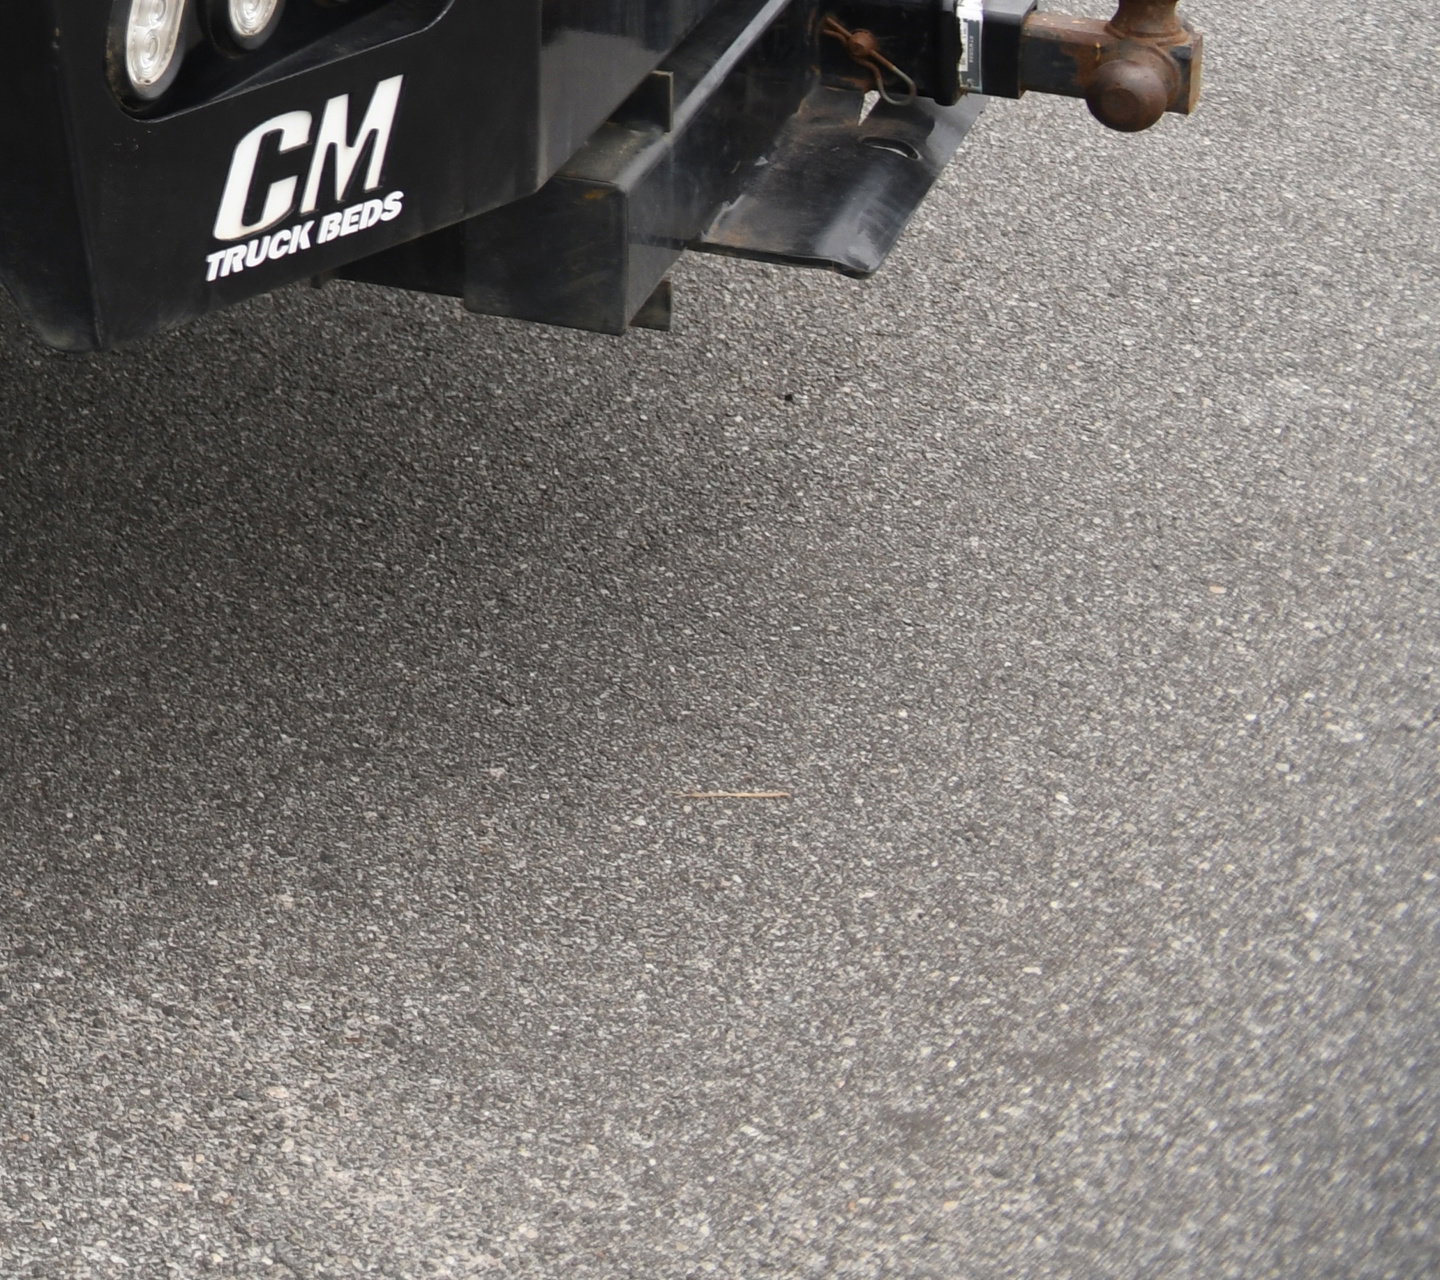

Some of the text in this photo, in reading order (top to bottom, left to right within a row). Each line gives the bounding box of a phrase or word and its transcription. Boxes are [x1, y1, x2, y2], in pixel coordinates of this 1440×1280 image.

[213, 74, 404, 240] CM
[205, 190, 404, 282] TRUCK BEDS
